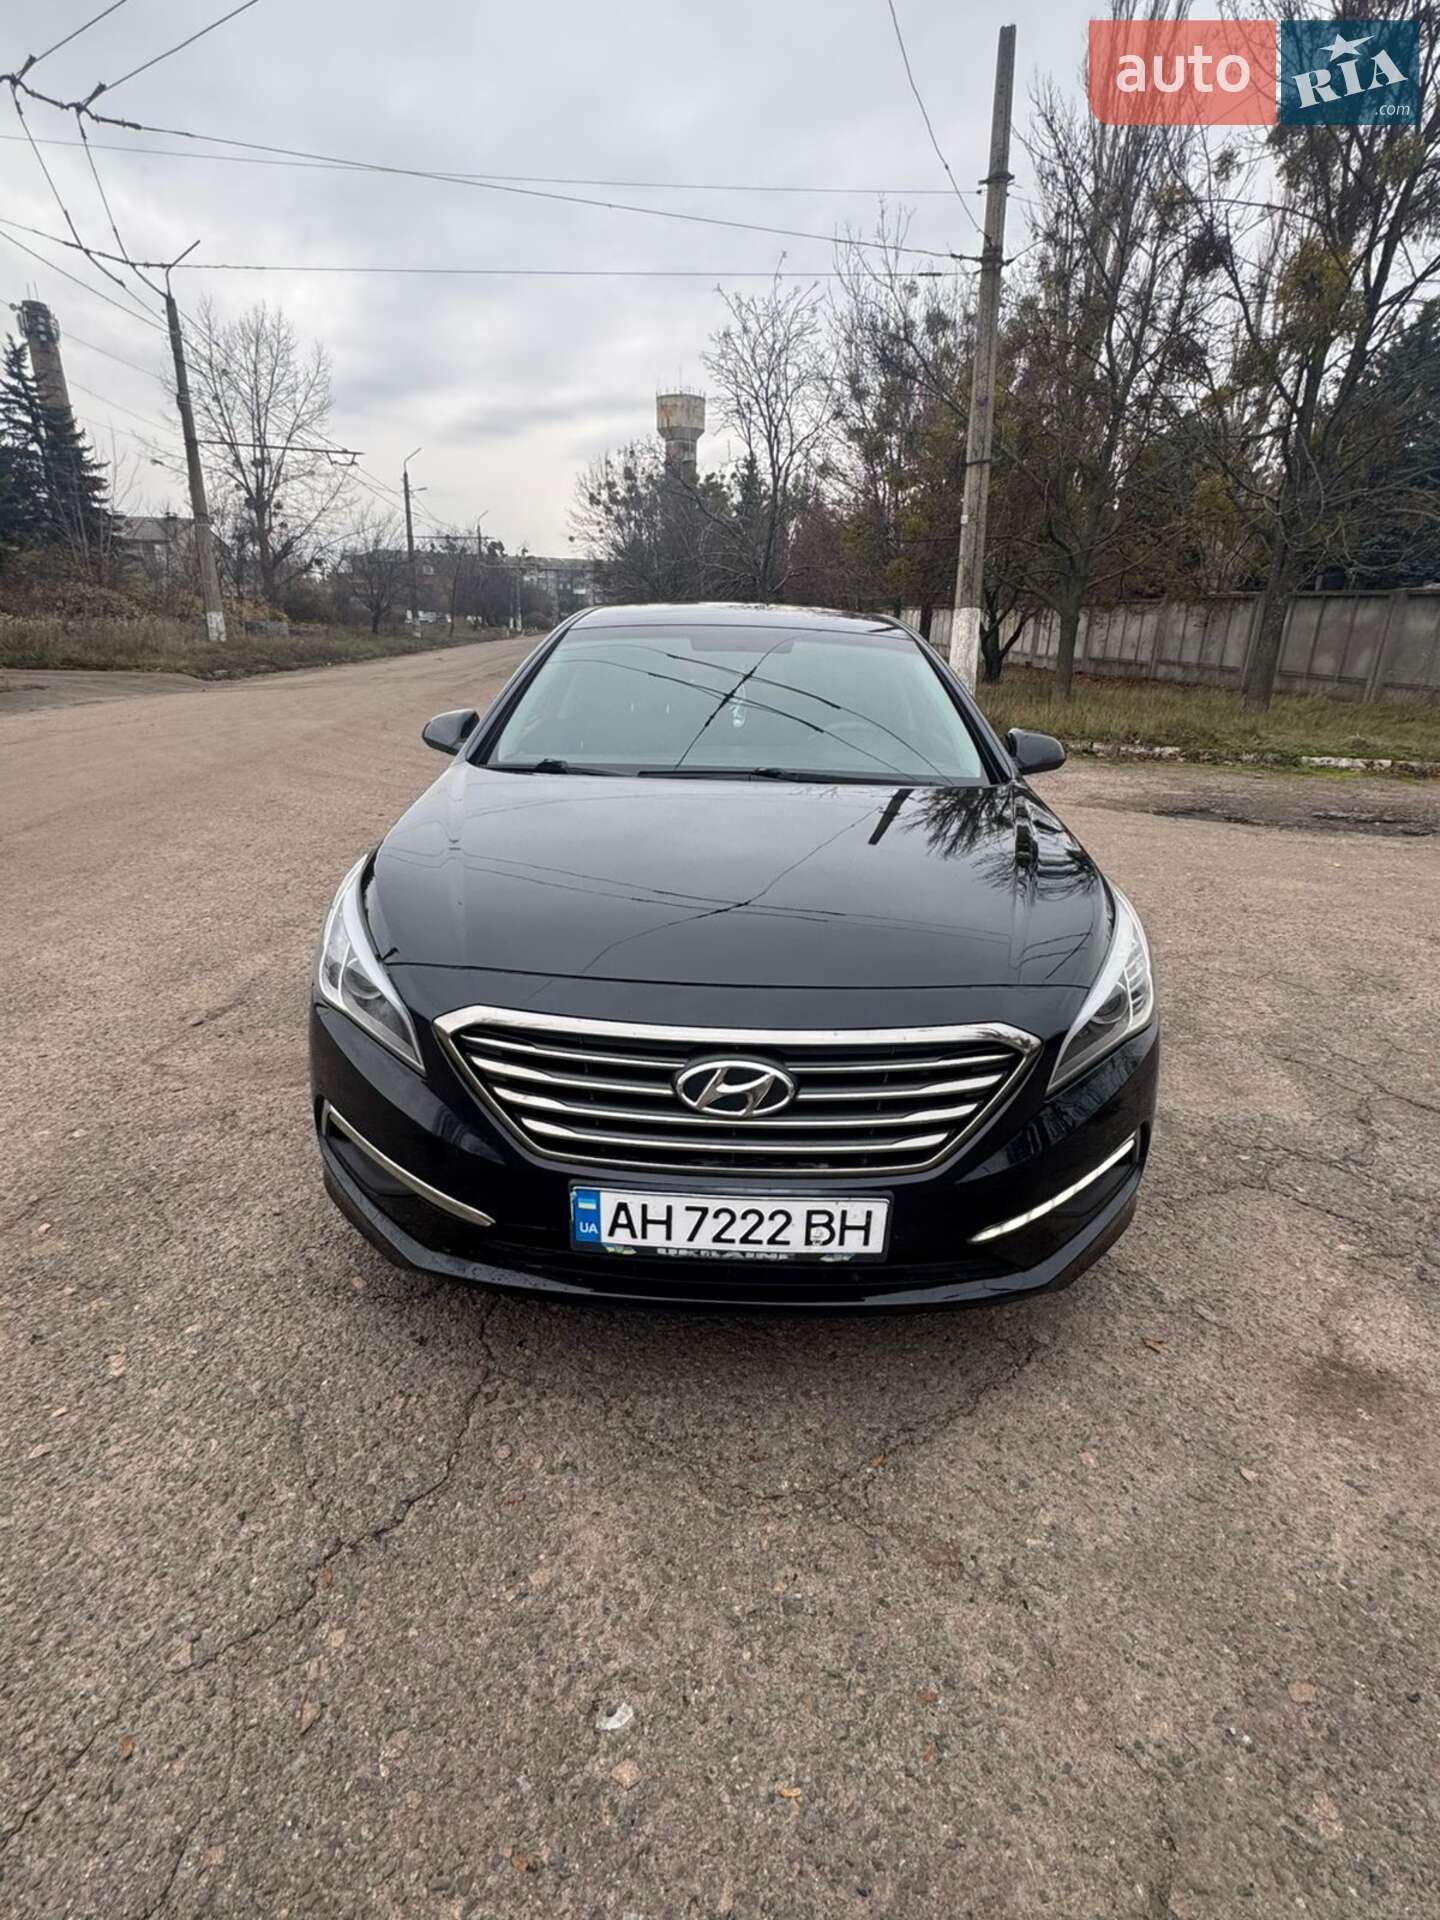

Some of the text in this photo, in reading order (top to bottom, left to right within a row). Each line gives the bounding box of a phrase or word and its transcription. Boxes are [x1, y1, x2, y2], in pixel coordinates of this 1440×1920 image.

[579, 1221, 599, 1235] UA
[607, 1202, 872, 1247] AH 7222 BH
